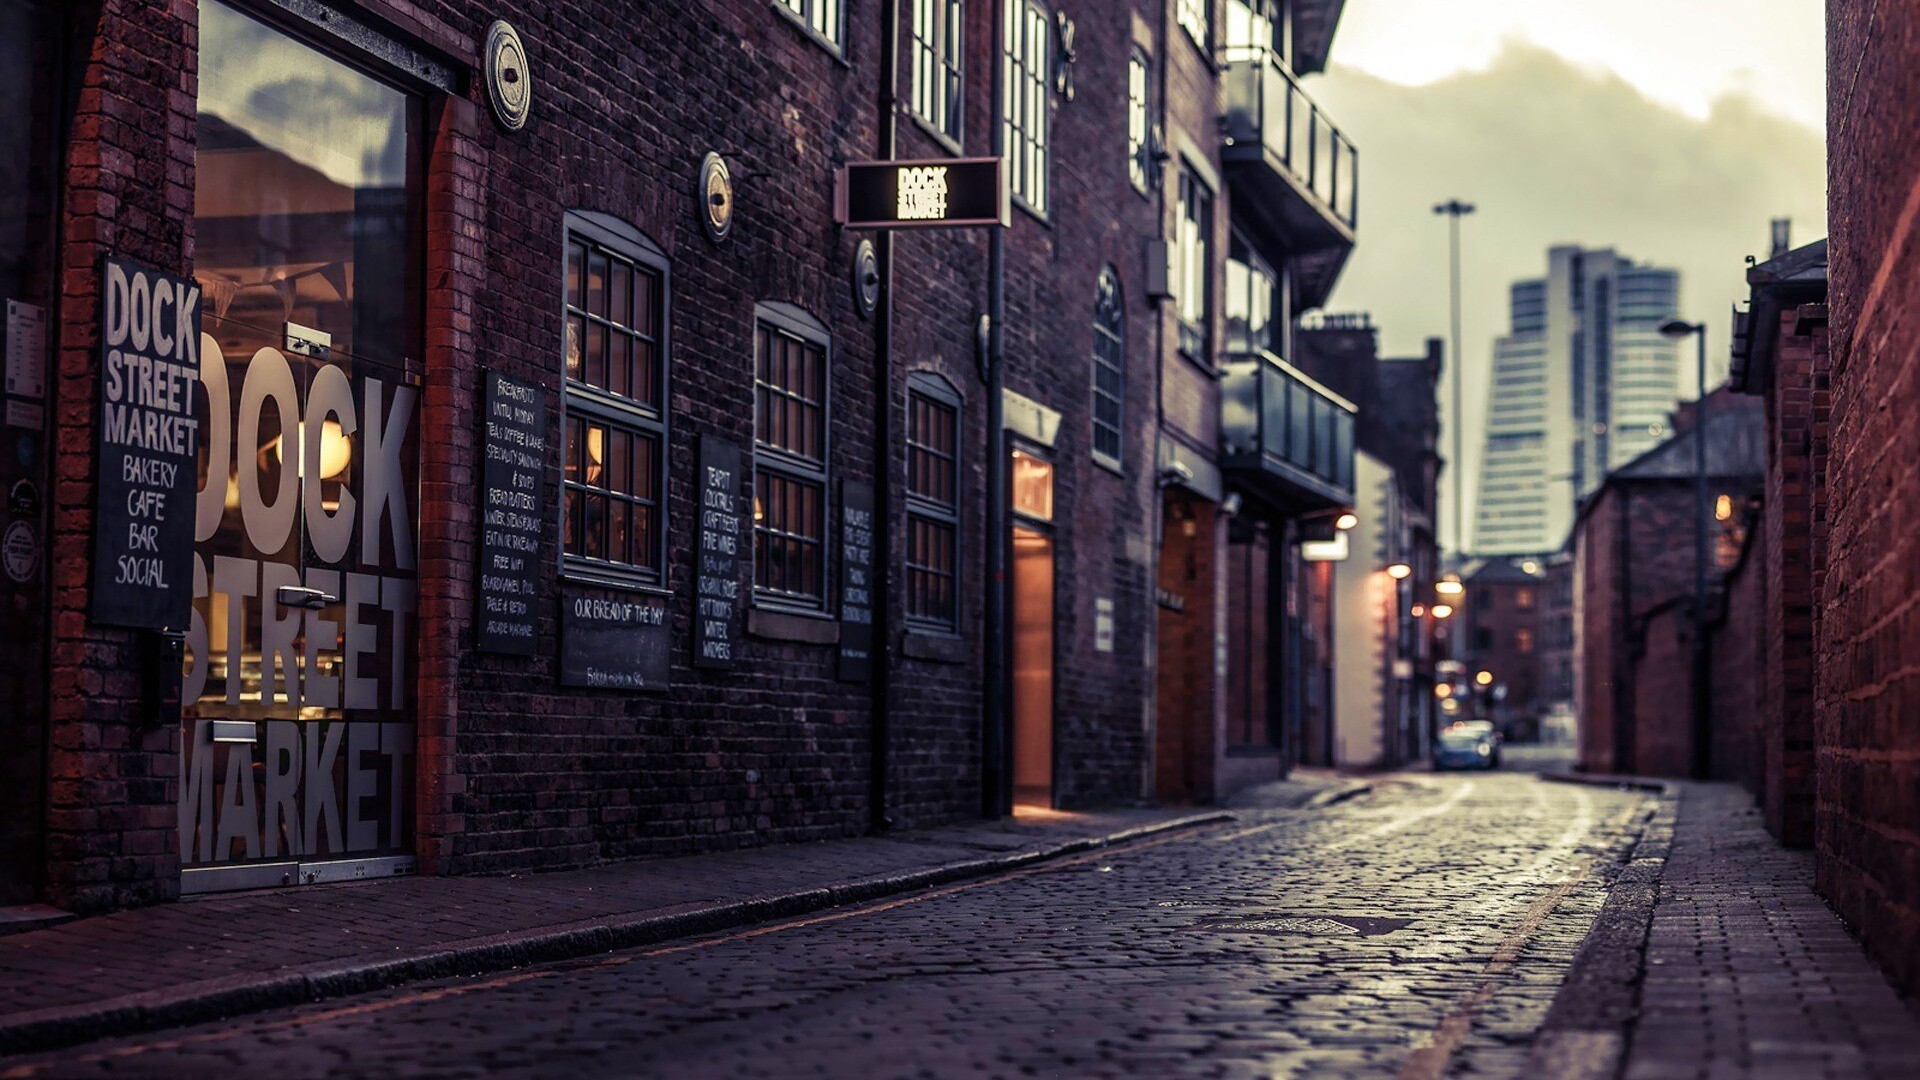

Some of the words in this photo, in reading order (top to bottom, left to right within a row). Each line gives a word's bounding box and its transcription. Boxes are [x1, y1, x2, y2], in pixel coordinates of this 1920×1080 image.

[897, 167, 948, 190] DOCK
[897, 189, 947, 206] STREET
[897, 204, 946, 219] MARKET
[107, 262, 200, 365] DOCK
[105, 350, 198, 416] STREET
[104, 402, 198, 457] MARKET
[486, 421, 503, 439] TEAS
[504, 426, 525, 446] COFFEE
[195, 331, 418, 570] DOCK
[123, 455, 178, 489] BAKERY
[127, 489, 165, 522] CAFE
[129, 521, 158, 552] BAR
[115, 555, 169, 589] SOCIAL
[493, 554, 509, 569] FREE
[575, 598, 592, 619] OUR
[593, 599, 620, 621] BREAD
[622, 604, 633, 622] OF
[635, 605, 649, 624] THE
[181, 550, 416, 711] STREET
